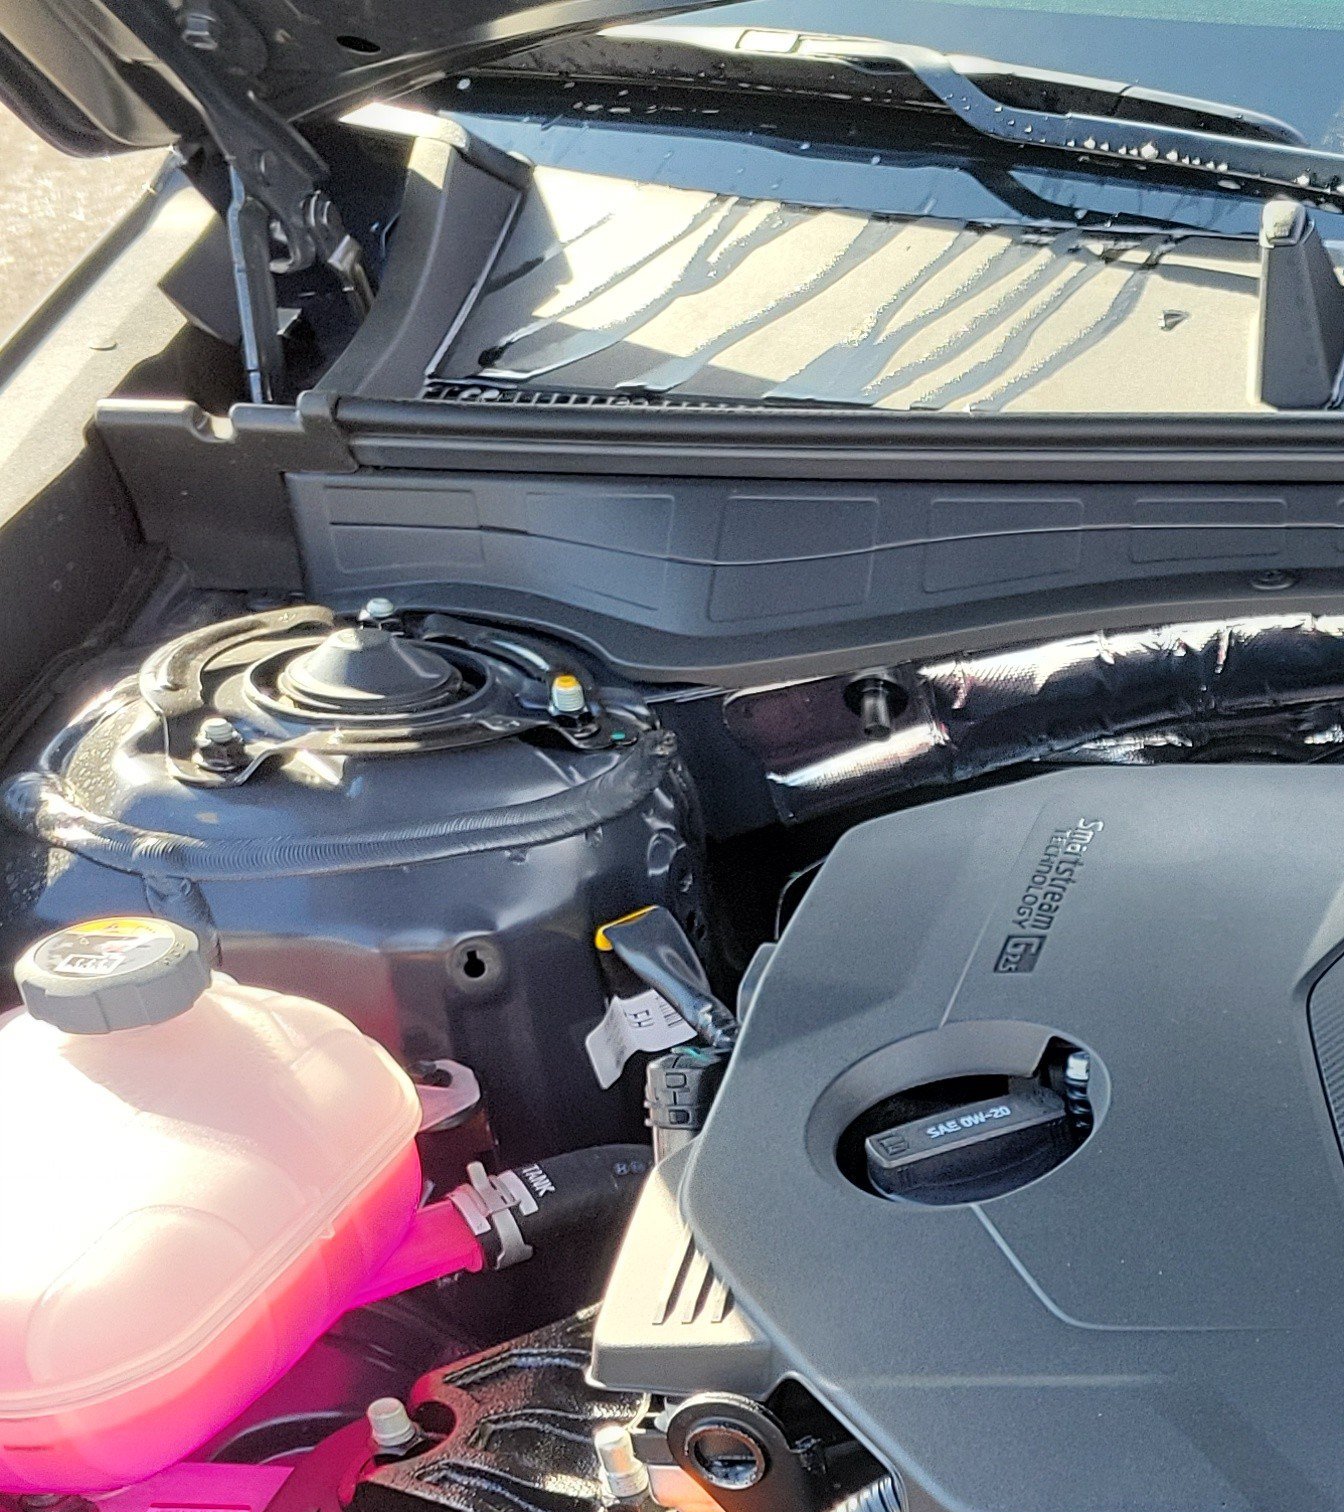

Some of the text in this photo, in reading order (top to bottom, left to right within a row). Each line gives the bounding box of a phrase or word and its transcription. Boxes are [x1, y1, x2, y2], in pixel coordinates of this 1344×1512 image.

[1012, 829, 1074, 931] TECHNOLOGY
[1031, 817, 1106, 932] Smartstream
[925, 1104, 1012, 1140] SAE 0W-20
[521, 1163, 556, 1198] TANK
